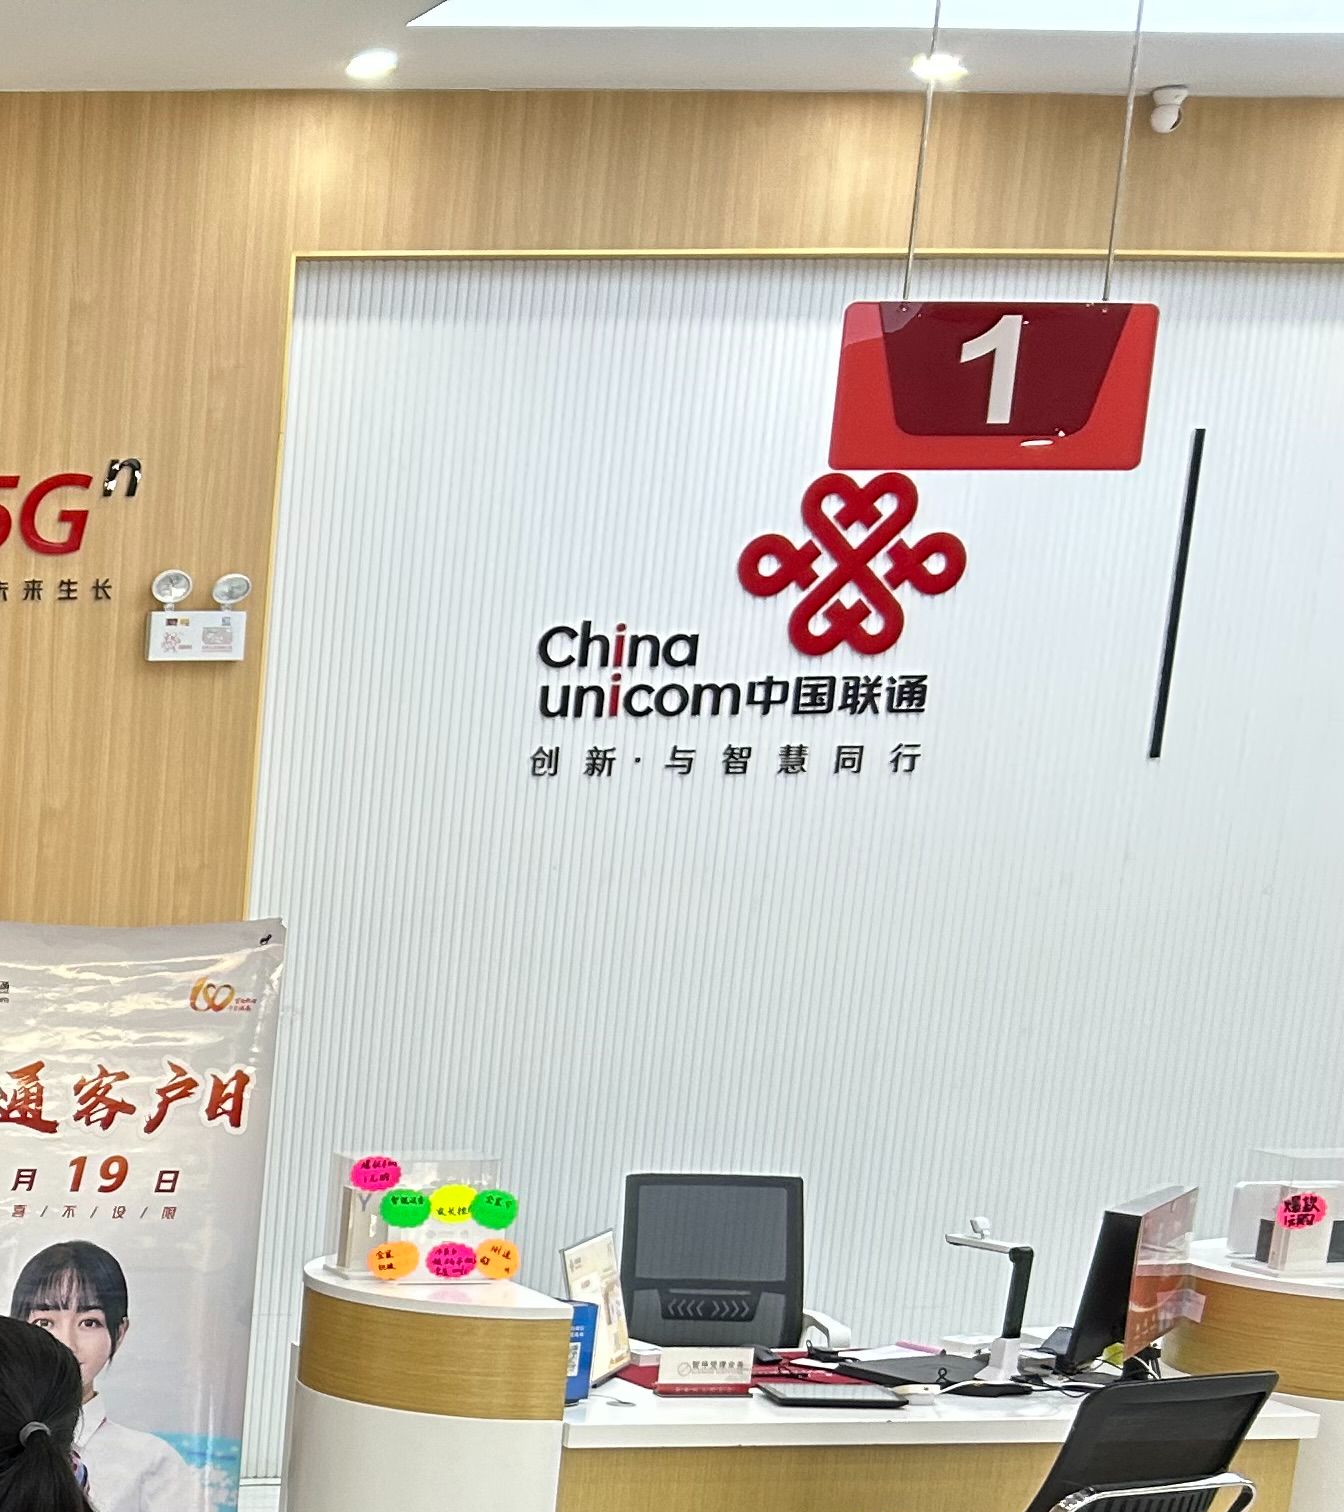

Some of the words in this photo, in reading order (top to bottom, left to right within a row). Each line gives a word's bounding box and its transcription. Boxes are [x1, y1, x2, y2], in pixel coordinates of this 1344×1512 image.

[959, 315, 1024, 425] 1
[537, 620, 700, 669] China
[746, 674, 928, 716] 中国联通
